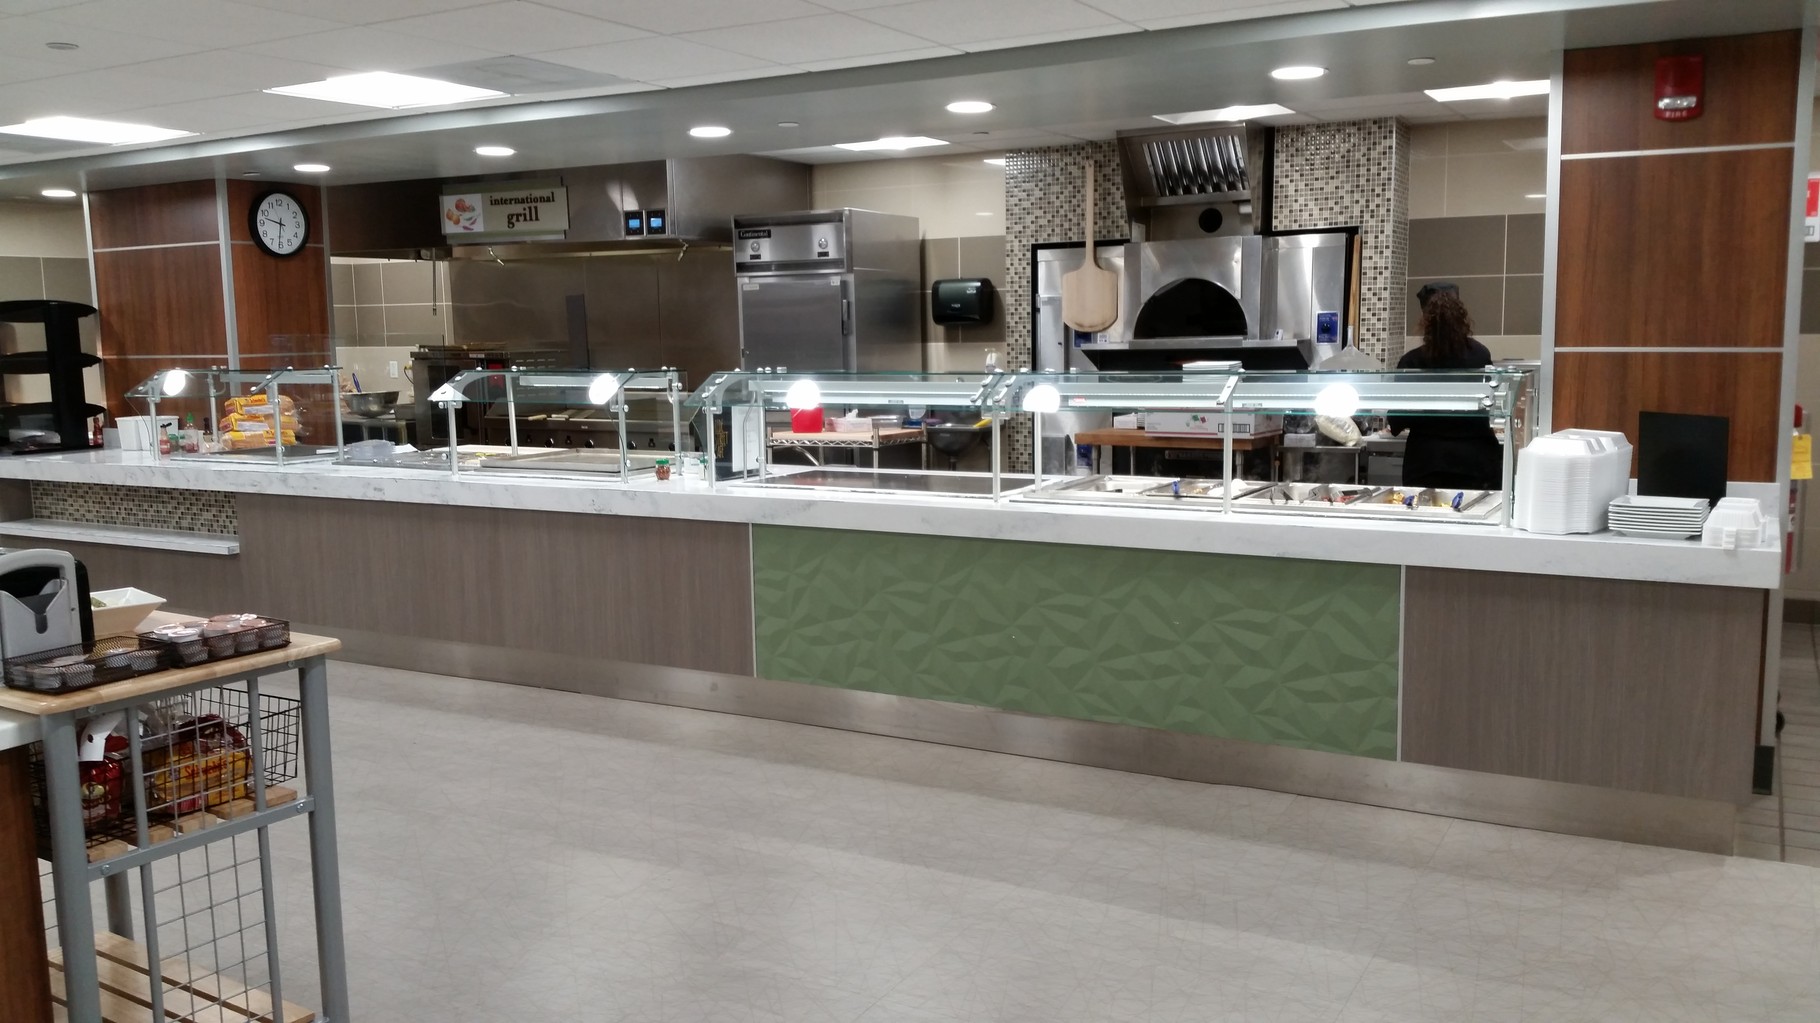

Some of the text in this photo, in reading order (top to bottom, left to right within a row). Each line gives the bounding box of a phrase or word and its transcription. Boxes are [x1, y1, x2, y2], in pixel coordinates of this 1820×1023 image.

[1665, 110, 1688, 118] FIRE
[275, 198, 283, 207] 12
[489, 191, 555, 206] international
[260, 209, 269, 217] 10
[507, 205, 540, 229] grill
[740, 230, 768, 238] Continental
